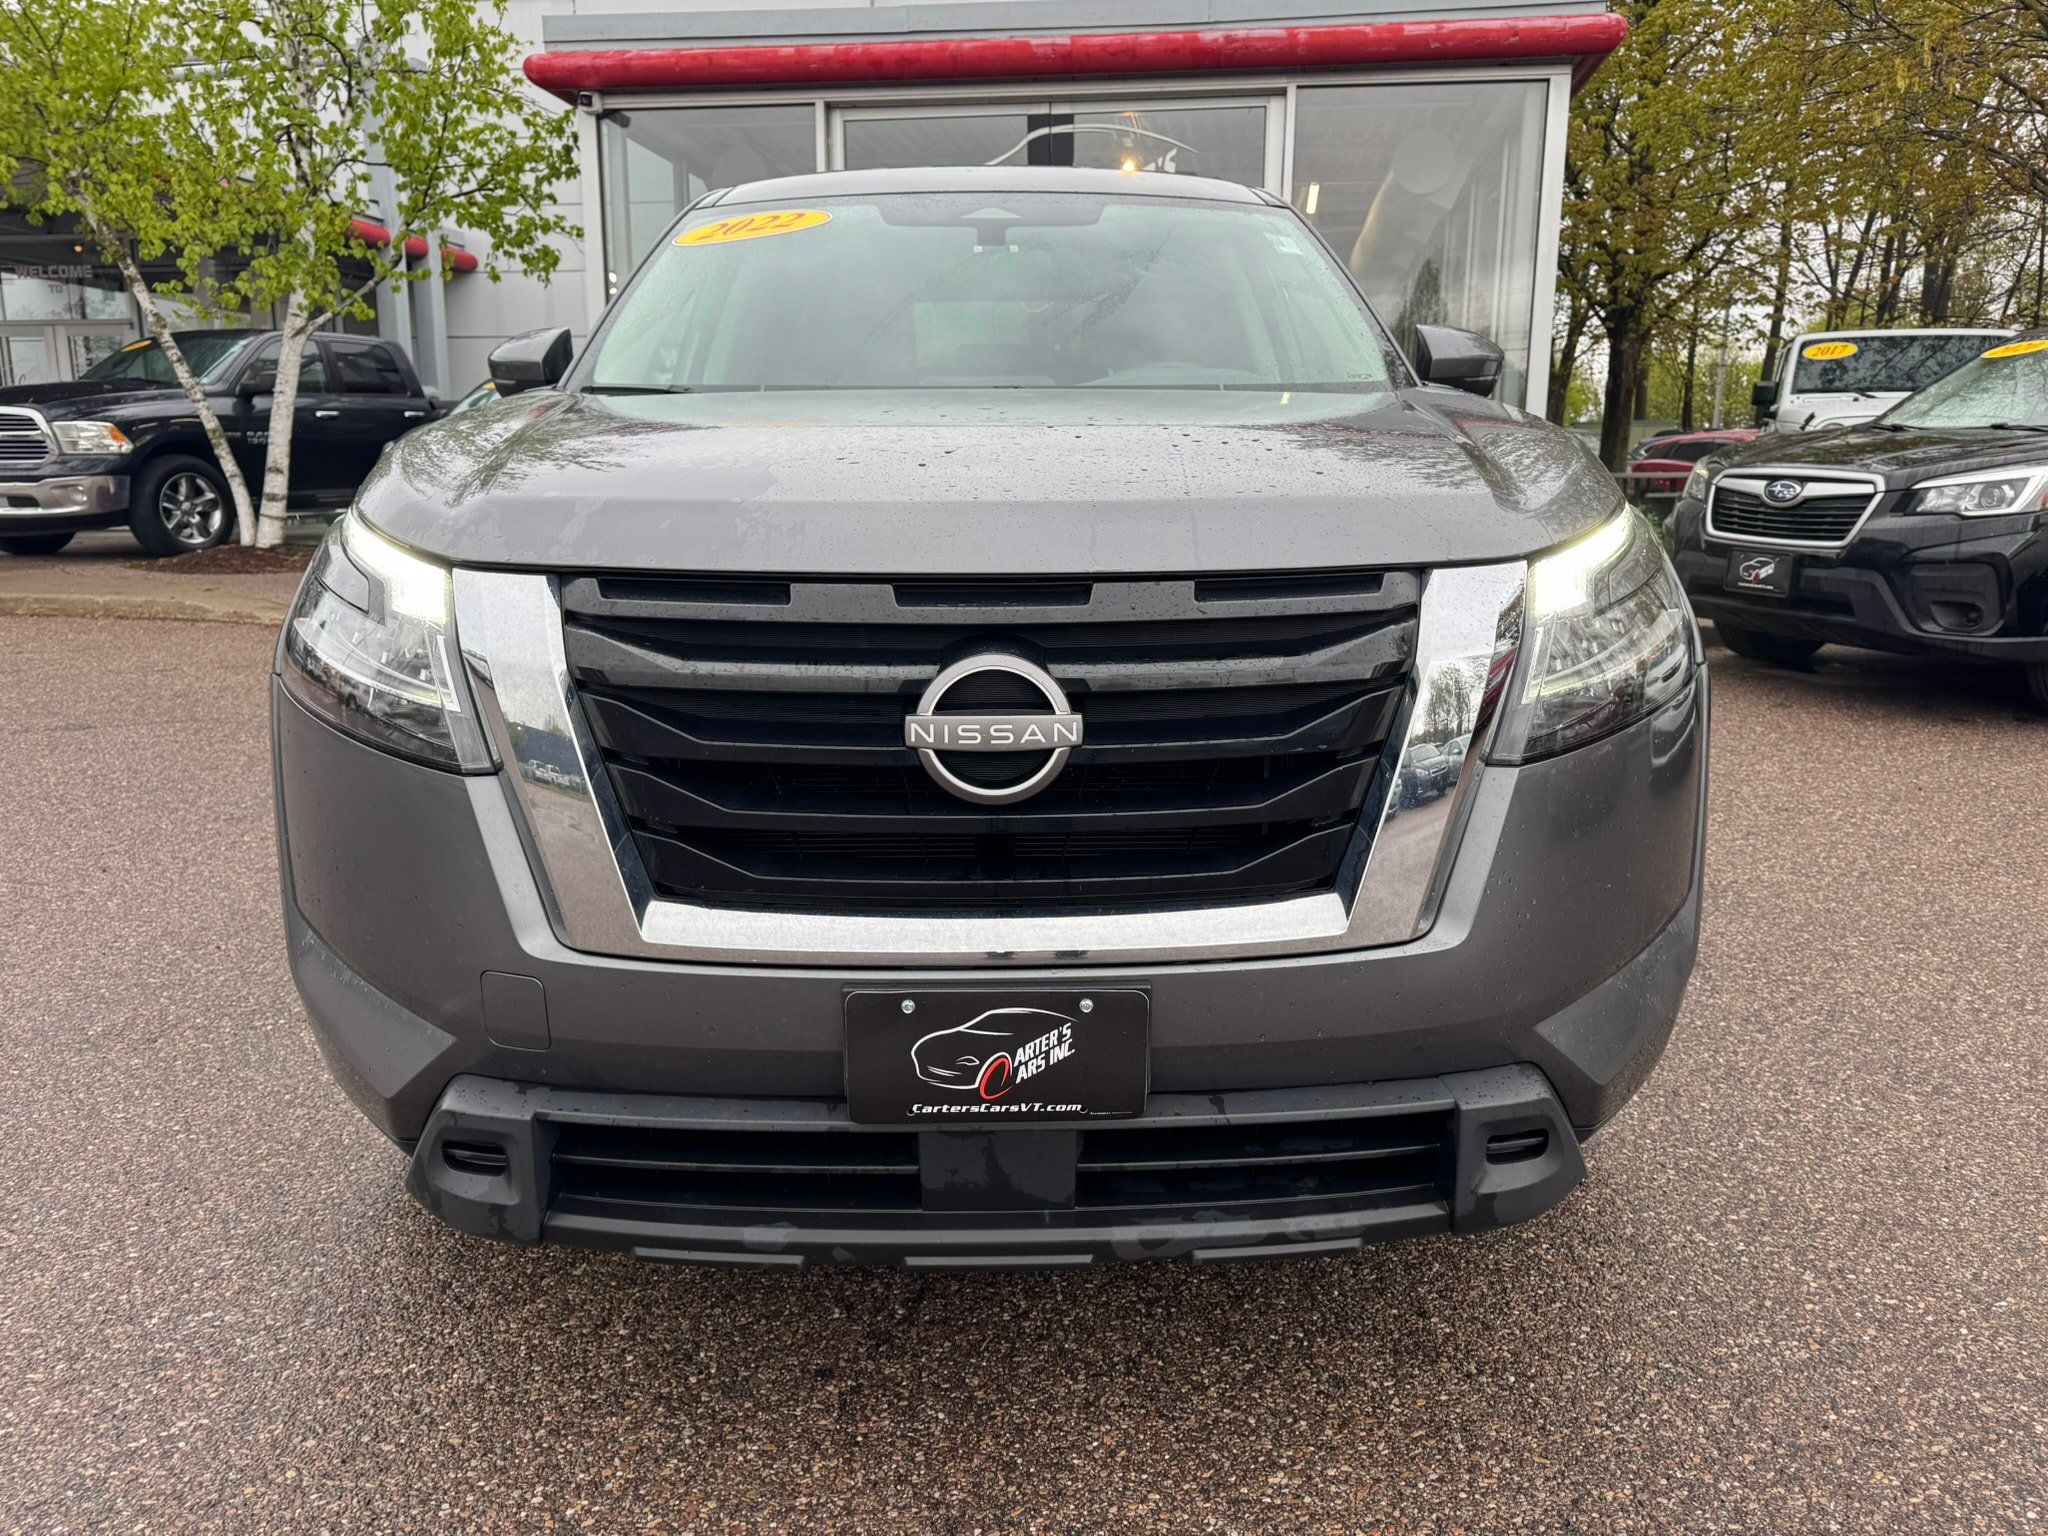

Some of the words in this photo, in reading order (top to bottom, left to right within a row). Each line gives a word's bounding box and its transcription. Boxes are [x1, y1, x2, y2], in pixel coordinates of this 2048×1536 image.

[694, 212, 806, 242] 2022
[14, 264, 94, 278] WELCOME
[47, 283, 64, 294] TO
[1811, 343, 1849, 357] 2017
[910, 722, 1077, 744] NISSAN
[1049, 1038, 1076, 1066] INC.
[911, 1102, 1083, 1114] CartersCarsVT.com
